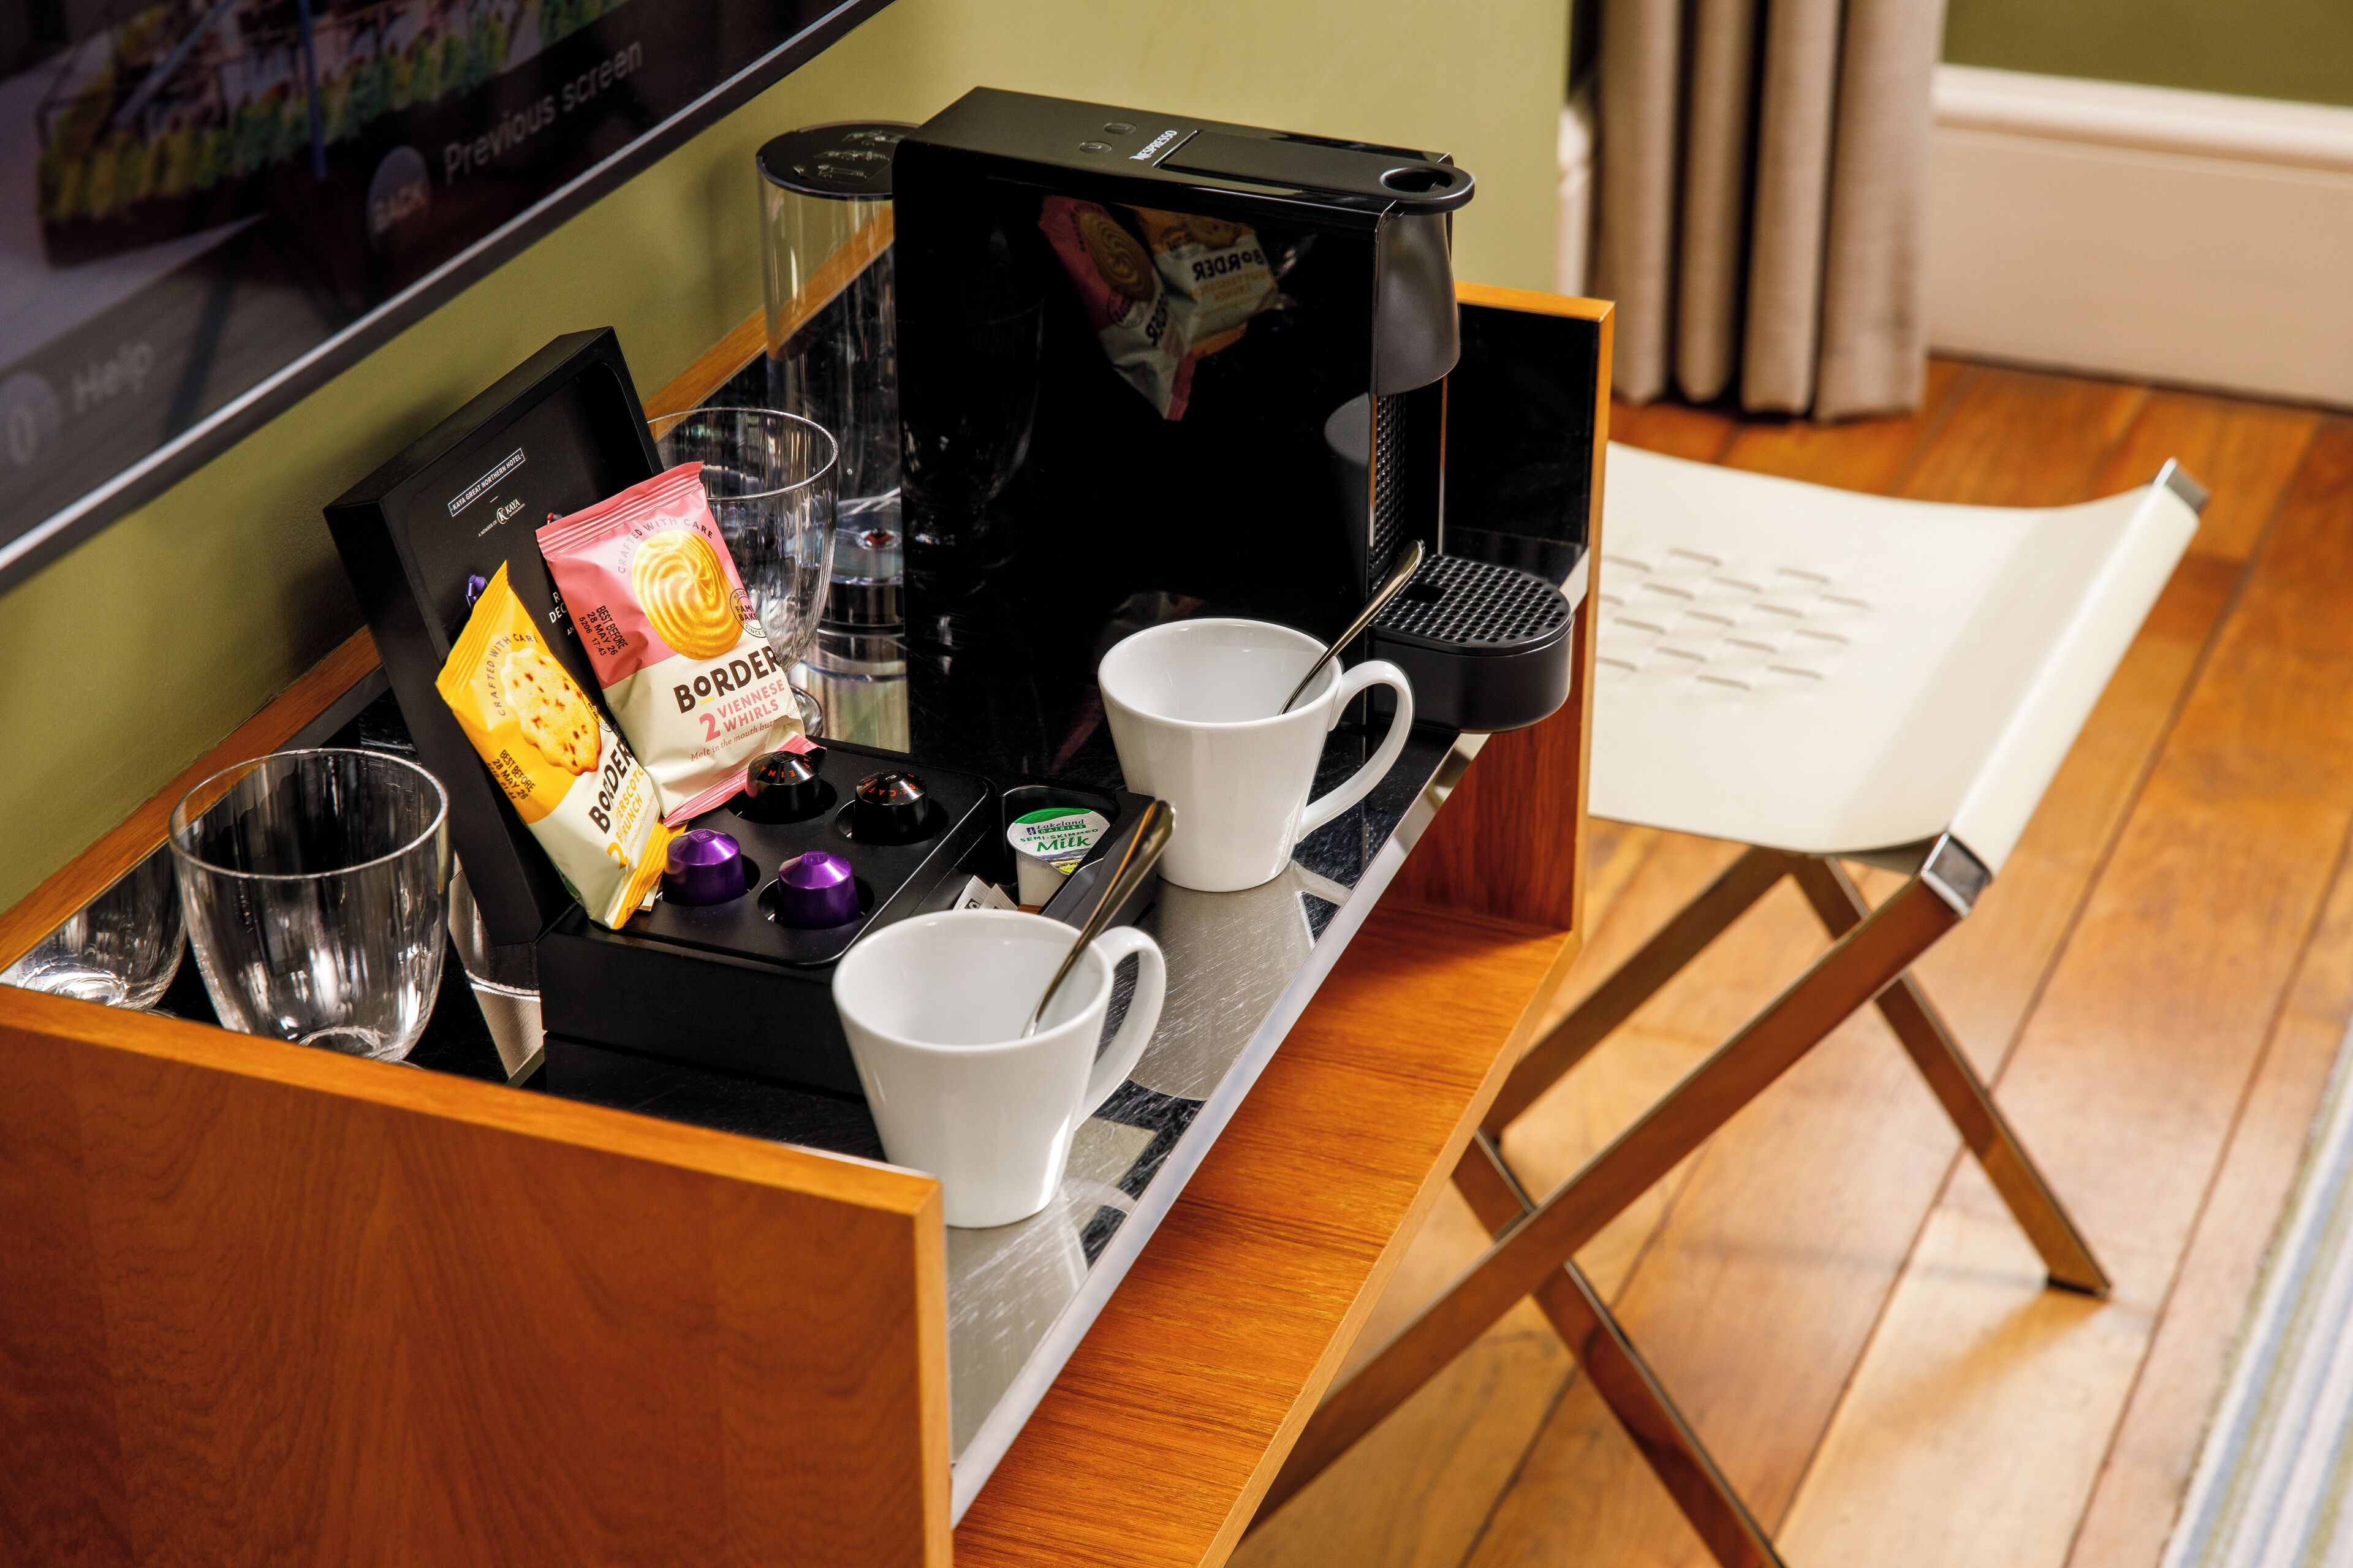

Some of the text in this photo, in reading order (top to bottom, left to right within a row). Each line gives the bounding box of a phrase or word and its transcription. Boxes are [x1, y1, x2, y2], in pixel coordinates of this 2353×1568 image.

[444, 40, 642, 184] Previous screen
[1129, 130, 1177, 160] NESPRESSO
[373, 184, 426, 235] BACK
[72, 341, 154, 413] Help
[452, 454, 522, 510] KAYA GREAT NORTHERN HOTEL
[504, 498, 521, 515] KAYA
[480, 523, 494, 536] MEMBER
[618, 518, 713, 574] CRAFTED WITH CARE
[488, 636, 511, 657] WITH
[579, 616, 607, 656] 5206 17:43
[586, 612, 618, 656] 28 MAY 26
[596, 605, 628, 650] BEST BEFORE
[745, 624, 762, 635] SINCE
[487, 661, 506, 716] CRAFTED
[673, 645, 781, 714] BORDER
[699, 679, 785, 743] 2 VIENNESE
[722, 699, 779, 733] WHIRLS
[691, 748, 710, 762] Melt
[711, 744, 720, 753] in
[721, 738, 732, 749] the
[733, 727, 758, 743] mouth
[492, 759, 528, 800] 28 MAY 26
[499, 749, 536, 793] BEST BEFORE
[1020, 828, 1099, 842] SEMI-SKIMMED
[1037, 819, 1085, 829] Lakeland
[1037, 836, 1091, 852] Milk
